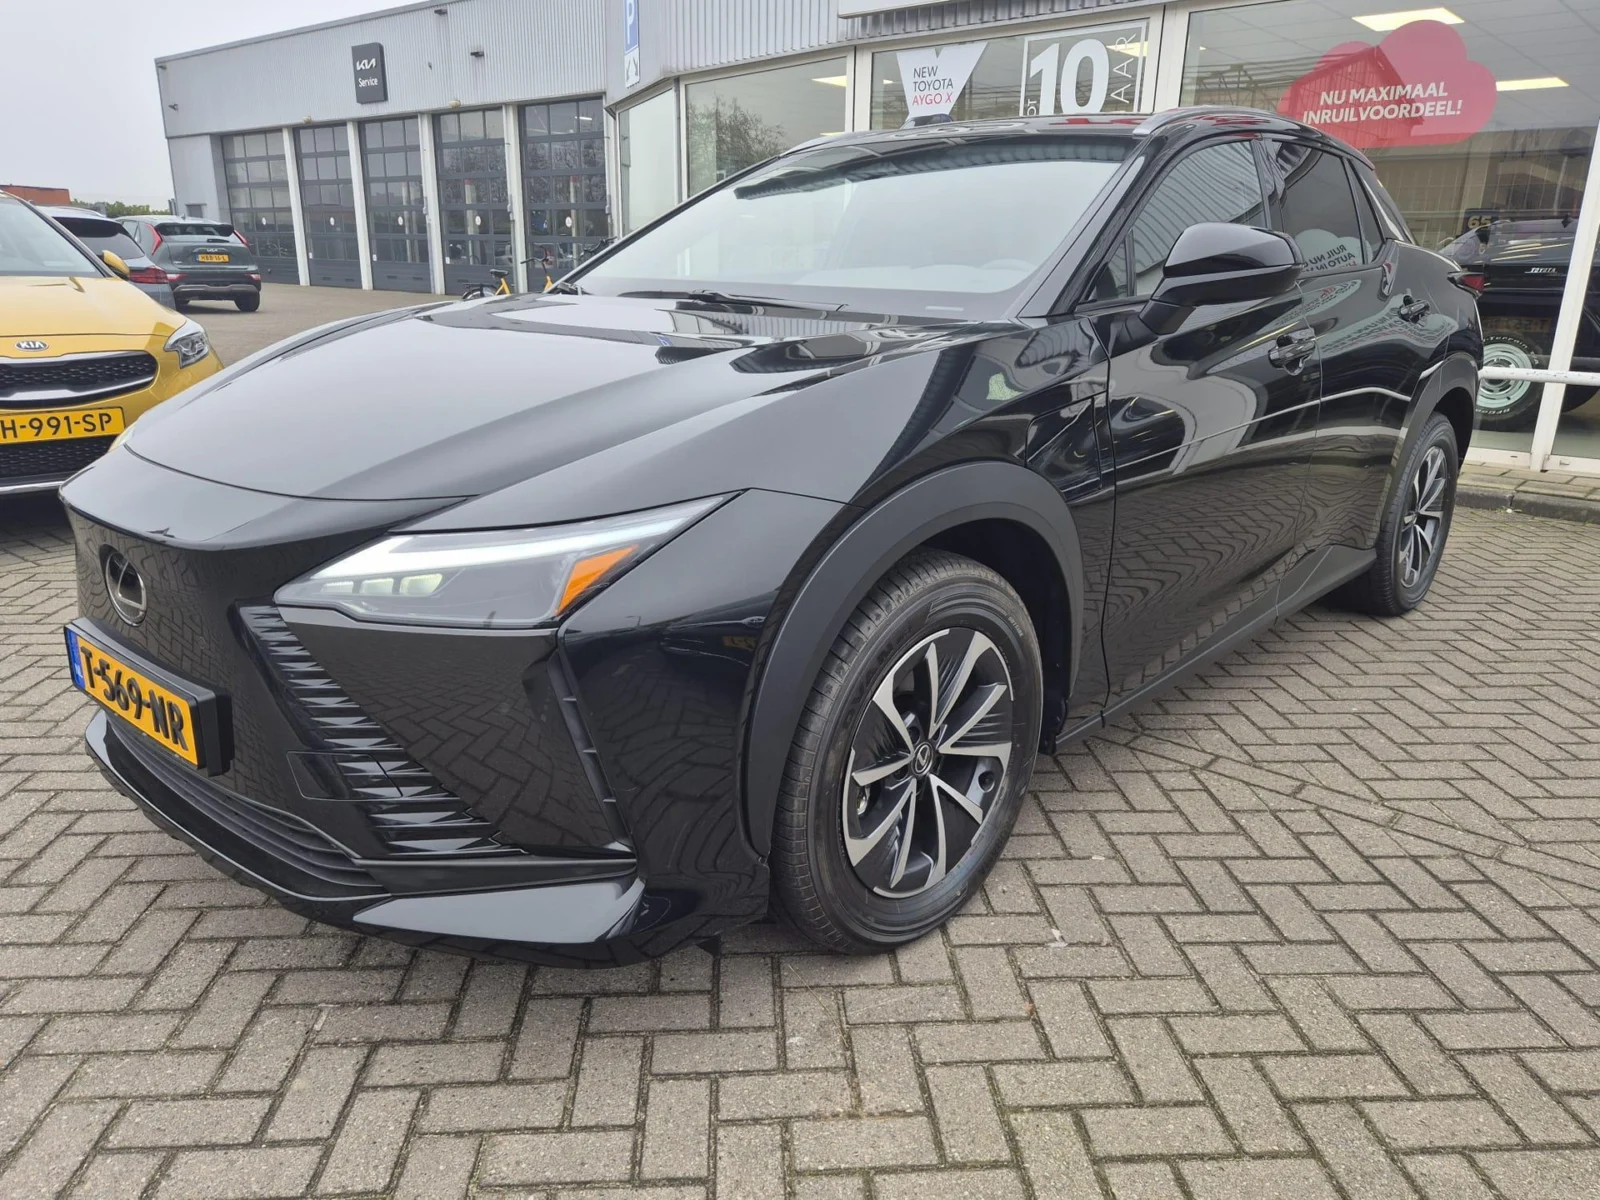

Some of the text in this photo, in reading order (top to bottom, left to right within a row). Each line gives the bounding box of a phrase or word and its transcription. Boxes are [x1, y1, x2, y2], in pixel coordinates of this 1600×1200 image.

[626, 0, 635, 45] P
[356, 58, 377, 71] KIA
[913, 65, 938, 79] NEW
[1029, 38, 1110, 116] 10
[1110, 33, 1137, 113] AAR
[358, 77, 379, 88] Service
[912, 78, 954, 92] TOYOTA
[1320, 81, 1448, 106] NU MAXIMAAL
[912, 92, 953, 106] AYGO X
[1302, 99, 1464, 125] INRUILVOORDEEL!
[19, 341, 46, 349] KIA
[1, 412, 113, 440] H-991-SP
[80, 646, 190, 752] T-569-NR
